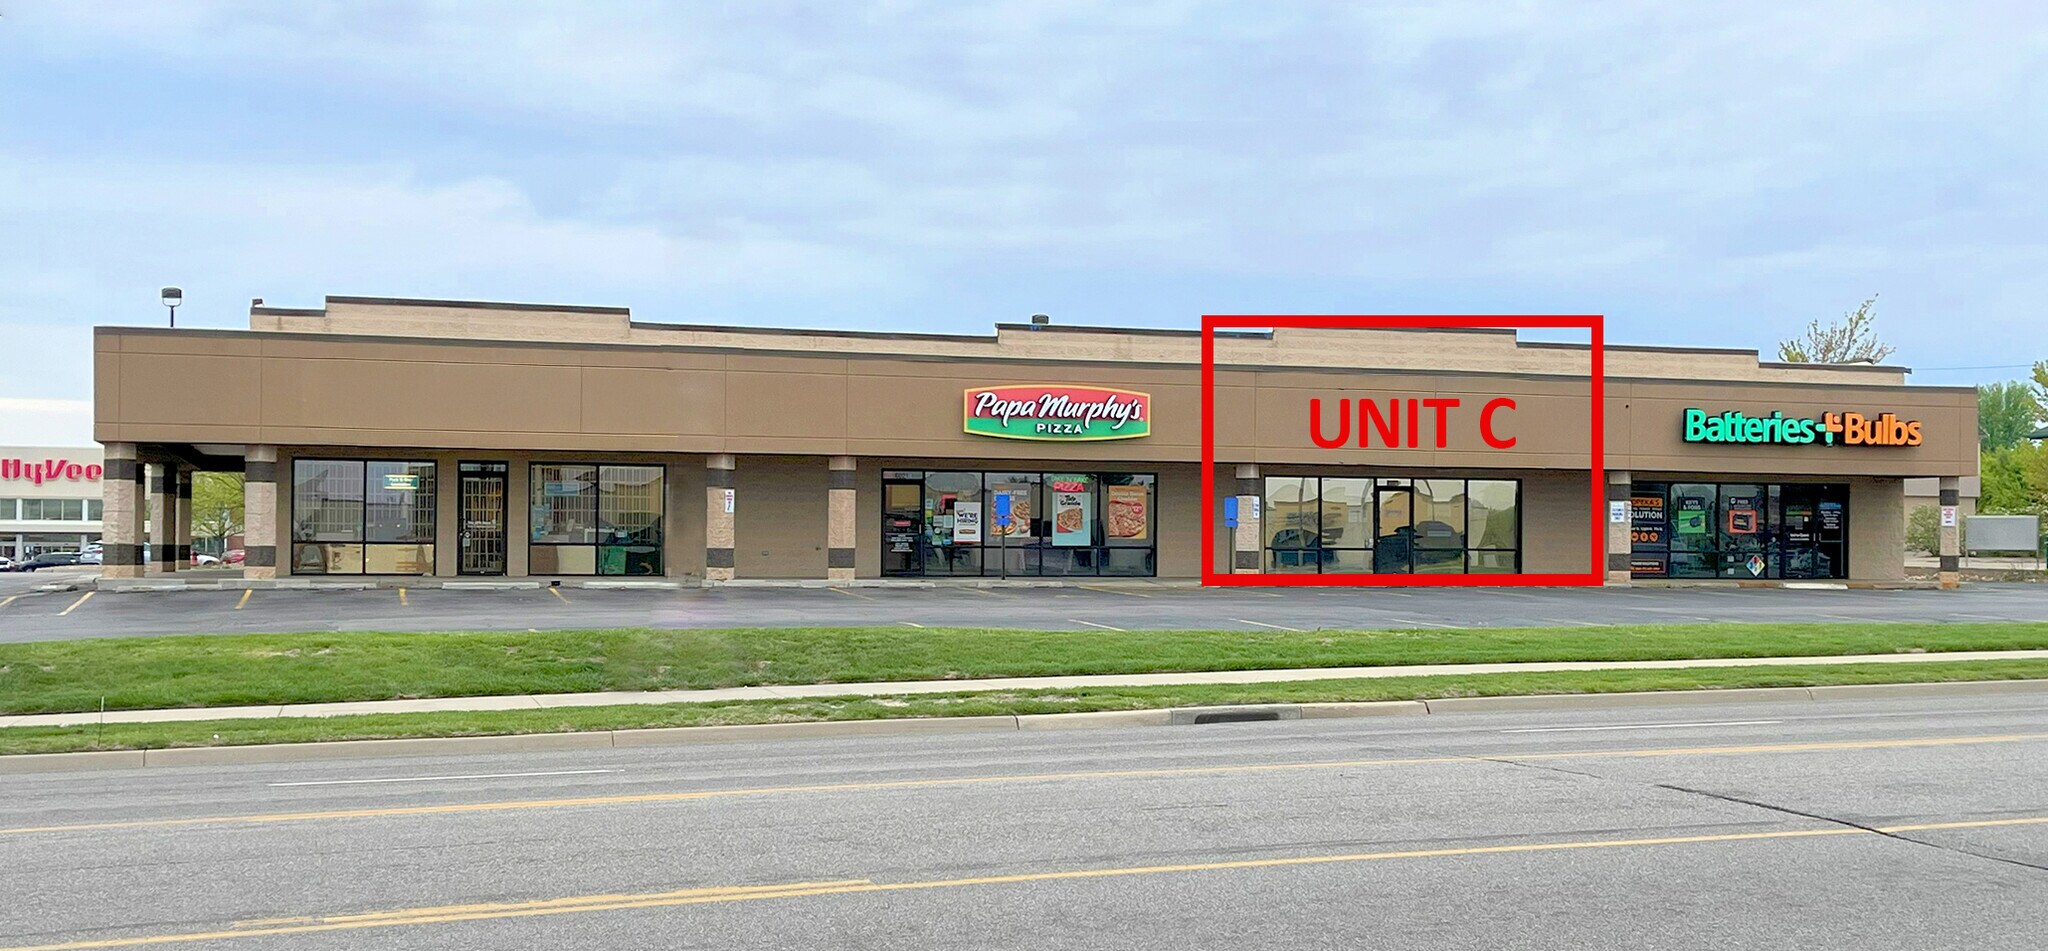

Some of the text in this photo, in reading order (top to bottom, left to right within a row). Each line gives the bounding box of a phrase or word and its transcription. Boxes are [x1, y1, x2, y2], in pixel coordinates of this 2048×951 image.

[975, 391, 1143, 430] Papa Murphy's
[1036, 423, 1083, 434] PIZZA
[1684, 408, 1815, 444] Batteries
[1844, 412, 1923, 446] Bulbs
[1053, 481, 1085, 492] PIZZA
[1631, 498, 1660, 506] OPEKA'S
[1629, 511, 1663, 519] OLUTION
